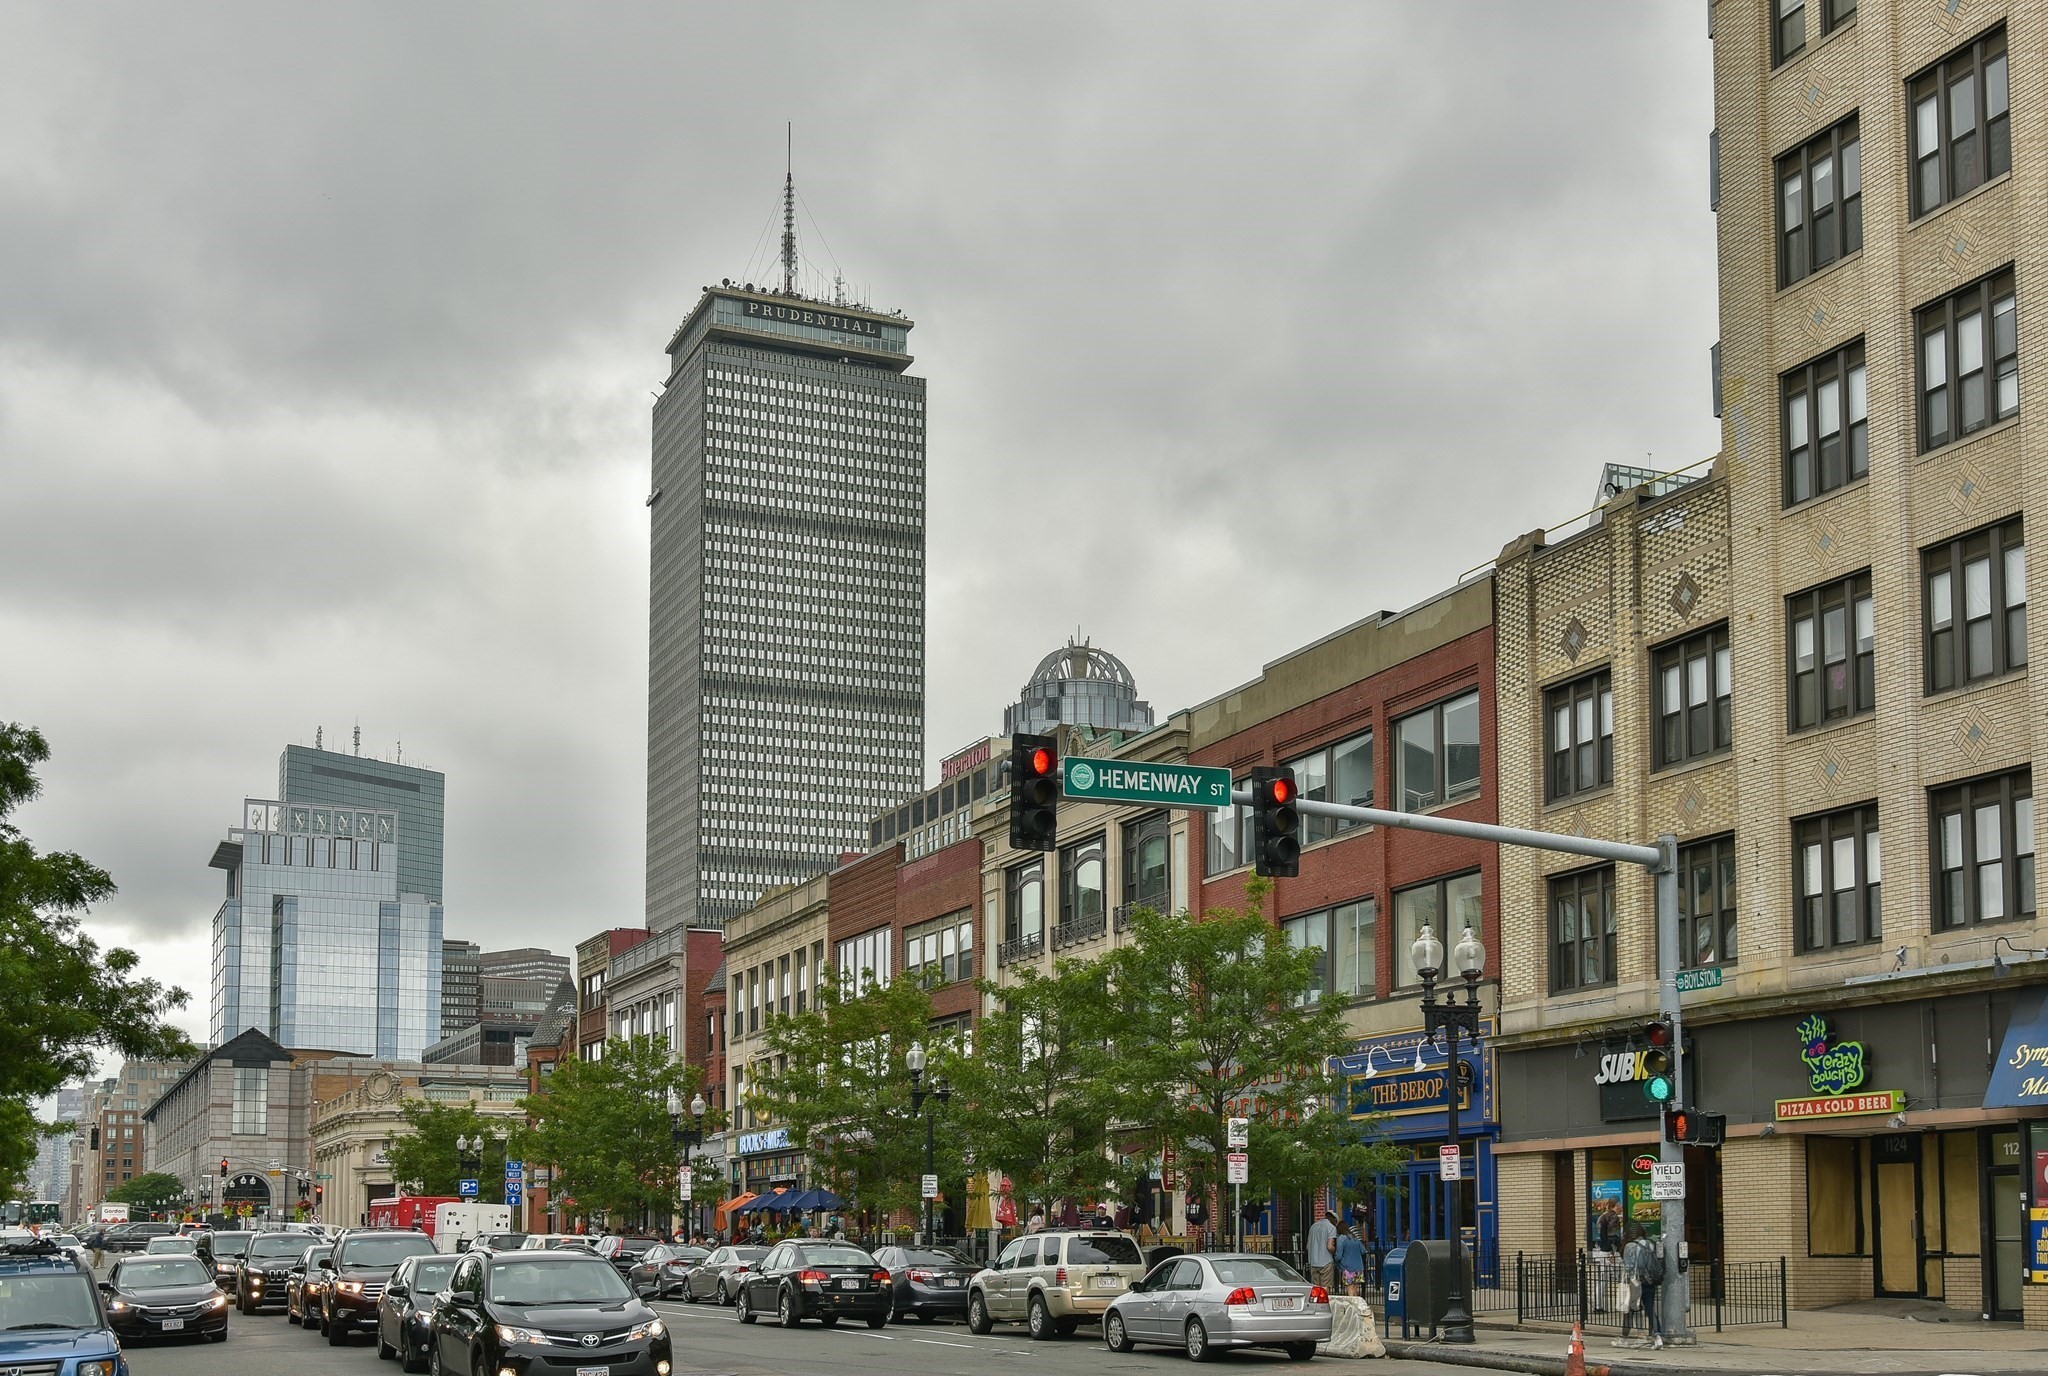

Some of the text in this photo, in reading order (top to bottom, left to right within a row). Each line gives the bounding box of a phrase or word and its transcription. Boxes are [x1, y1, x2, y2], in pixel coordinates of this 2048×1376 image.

[749, 302, 876, 334] PRUDENTIAL
[941, 744, 990, 782] Sheraton
[1099, 768, 1225, 797] HEMENWAY ST
[1684, 969, 1717, 990] BOYLSTON
[1812, 1064, 1857, 1084] DOUGH'S
[1371, 1078, 1443, 1105] THE BEBOP
[1780, 1096, 1888, 1116] PIZZA & COLD BEER
[739, 1133, 763, 1154] BOOKS
[1884, 1137, 1907, 1152] 1124
[1655, 1165, 1682, 1175] YIELD
[508, 1183, 520, 1191] 90
[1592, 1186, 1602, 1199] $6
[1628, 1184, 1642, 1201] $6
[1654, 1180, 1682, 1188] PEDESTRIANS
